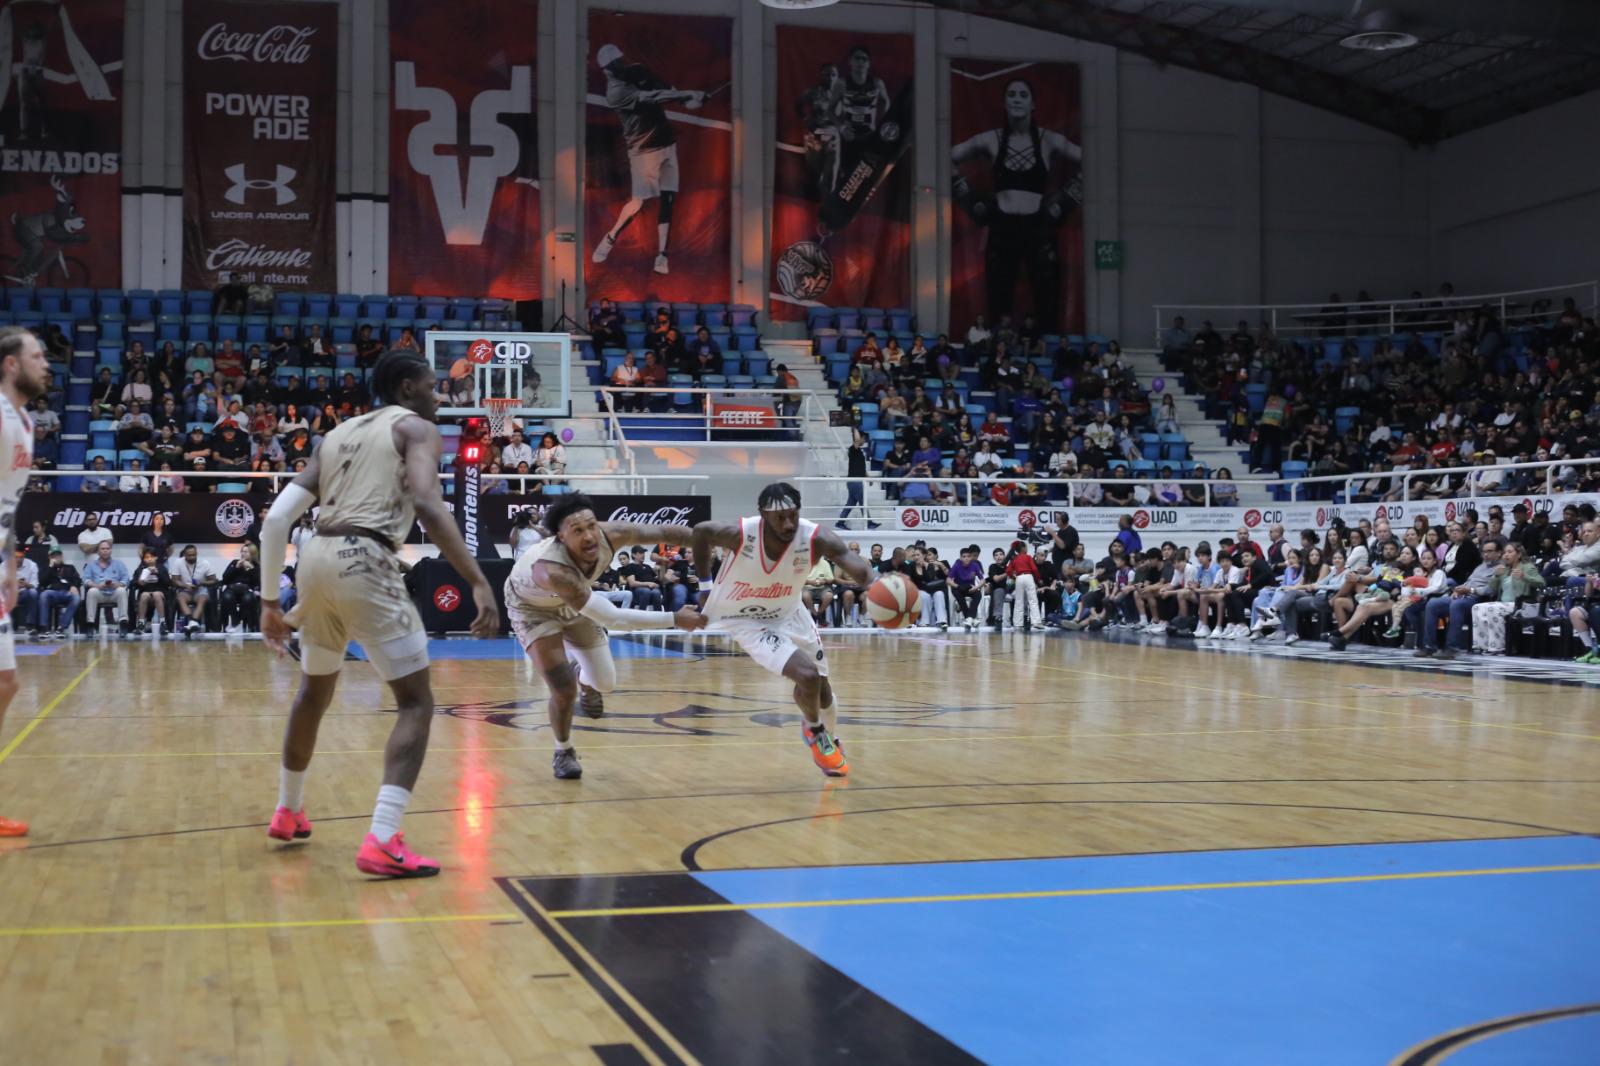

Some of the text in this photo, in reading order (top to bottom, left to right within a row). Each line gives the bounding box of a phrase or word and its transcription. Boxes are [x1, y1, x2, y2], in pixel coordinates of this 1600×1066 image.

[197, 23, 319, 64] Coca-Cola
[206, 92, 310, 117] POWER
[253, 117, 309, 140] ADE
[0, 149, 119, 175] ENADOS
[211, 211, 310, 221] UNDER ARMOUR
[206, 238, 312, 271] Caliente
[231, 271, 308, 285] alinte.mx
[495, 342, 531, 360] CID
[719, 410, 766, 425] TECATE
[53, 508, 172, 528] dprtens
[920, 509, 949, 523] UAD
[1038, 510, 1058, 524] CI
[1151, 510, 1177, 525] UAD
[1263, 510, 1283, 524] CID
[1387, 505, 1403, 521] CID
